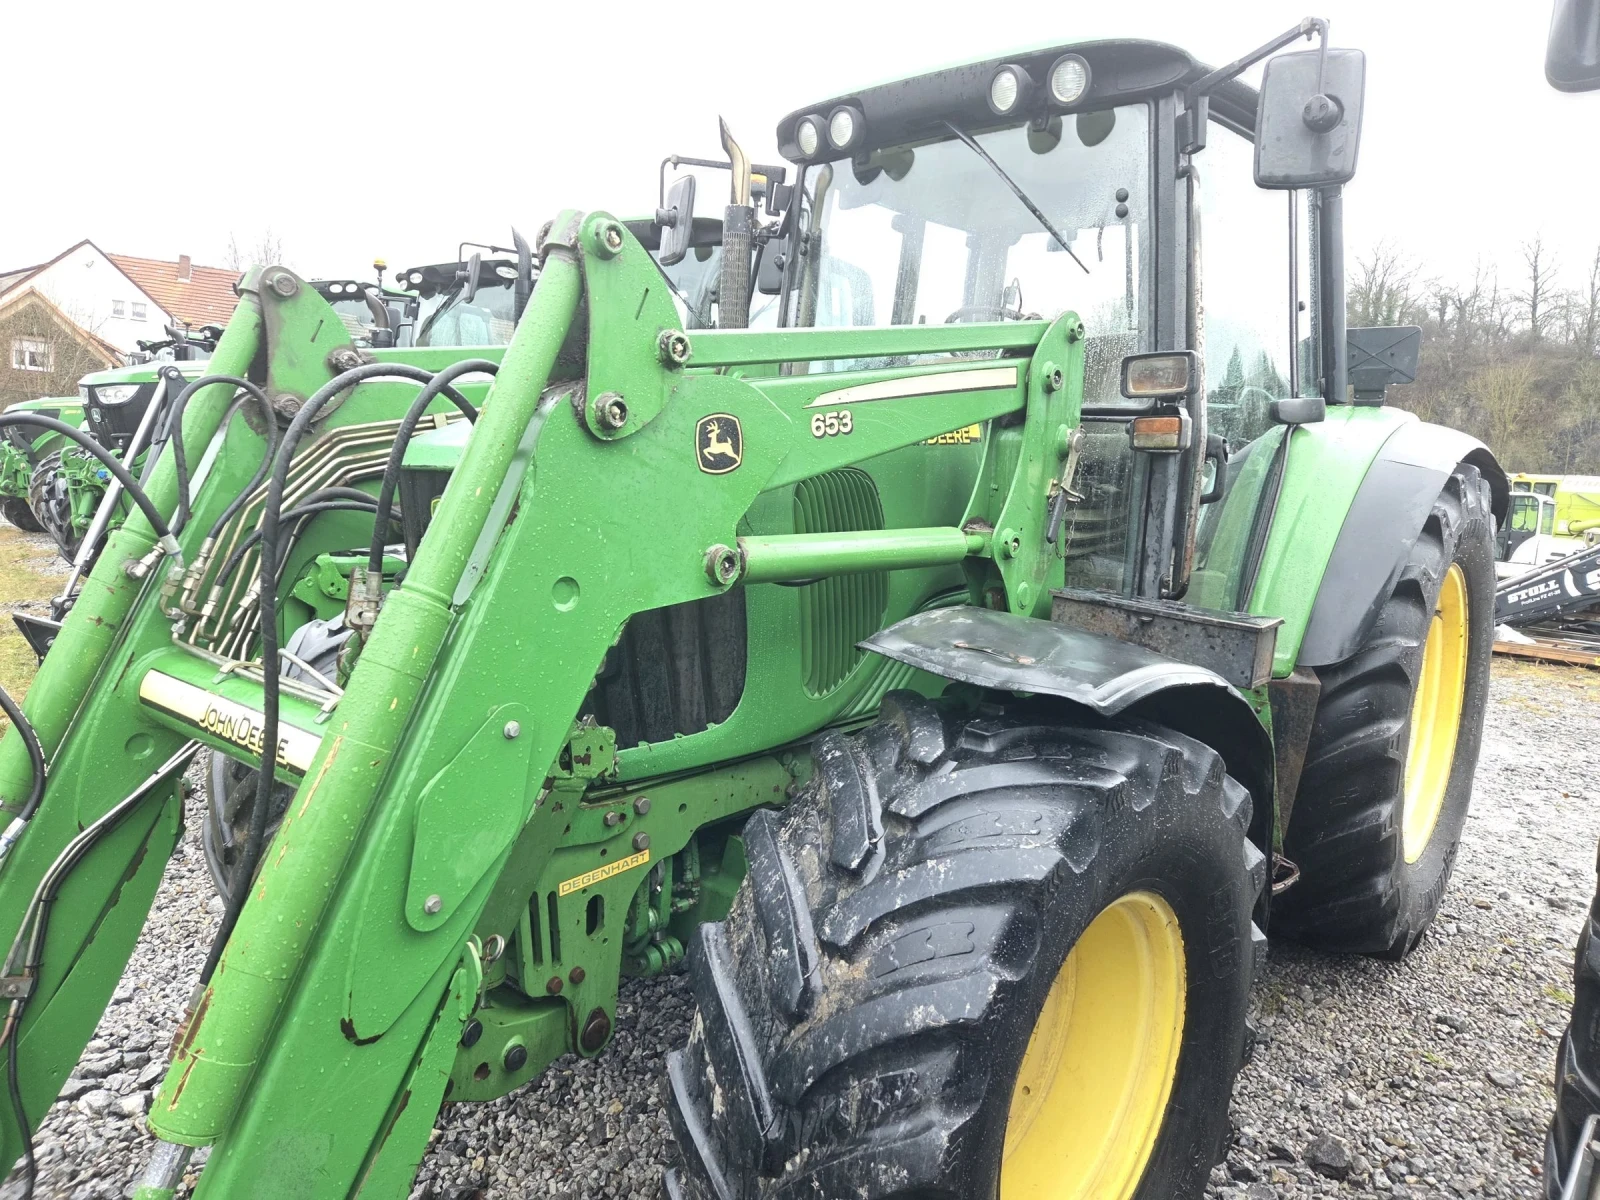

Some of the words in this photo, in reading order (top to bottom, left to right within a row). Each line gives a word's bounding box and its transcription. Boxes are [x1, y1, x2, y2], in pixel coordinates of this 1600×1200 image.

[811, 410, 852, 438] 653
[1507, 580, 1559, 604] STOLL
[199, 702, 239, 743] JOHN
[236, 717, 290, 765] DEEE
[561, 852, 647, 893] DEGENHART
